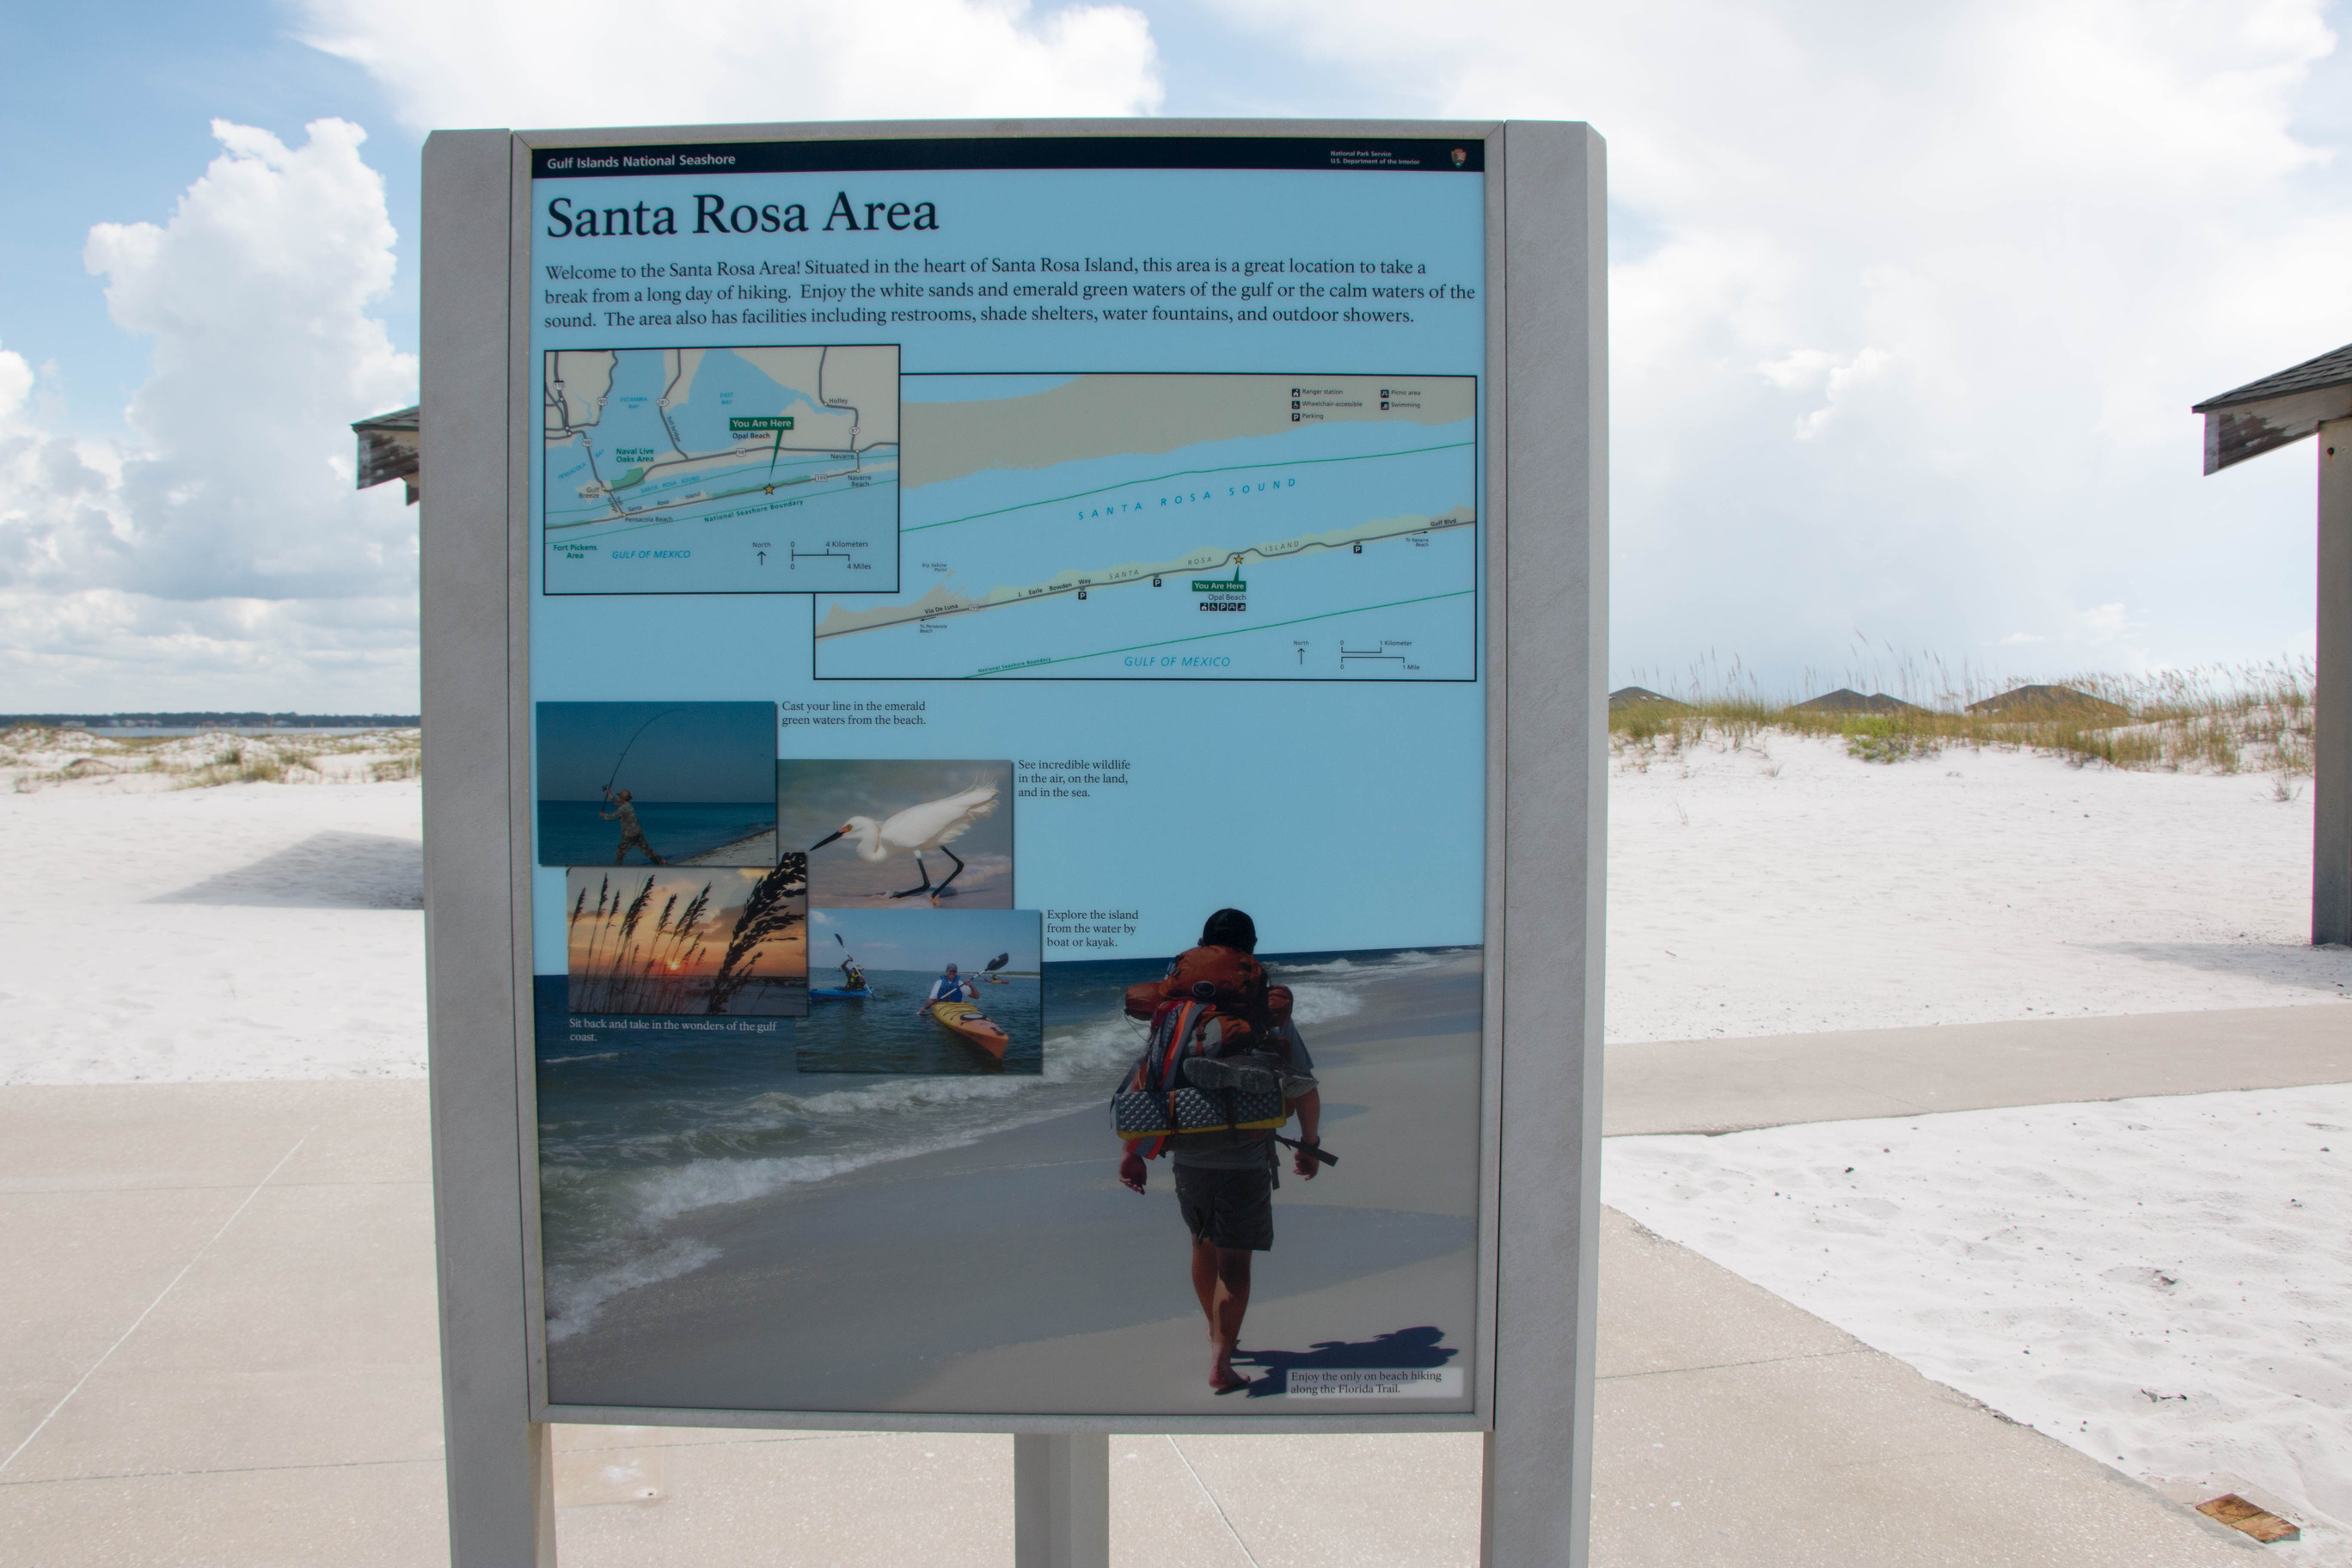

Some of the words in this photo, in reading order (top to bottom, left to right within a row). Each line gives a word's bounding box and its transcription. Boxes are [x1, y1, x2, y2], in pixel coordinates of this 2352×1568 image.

[547, 157, 573, 168] Gulf
[577, 156, 619, 168] Islands
[623, 155, 675, 167] National
[679, 154, 736, 165] Seashore
[547, 198, 677, 236] Santa
[692, 194, 809, 232] Rosa
[822, 191, 940, 230] Area
[544, 265, 616, 279] Welcome
[621, 266, 636, 278] to
[640, 263, 665, 277] the
[670, 262, 712, 276] Santa
[716, 261, 755, 275] Rosa
[759, 261, 799, 274] Area!
[805, 260, 869, 273] Situated
[874, 260, 889, 273] in
[894, 260, 919, 273] the
[924, 260, 966, 272] heart
[971, 259, 987, 272] of
[992, 259, 1036, 272] Santa
[1040, 259, 1080, 271] Rosa
[1085, 258, 1138, 273] Island,
[1142, 258, 1172, 271] this
[1177, 261, 1210, 272] area
[1215, 258, 1227, 272] is
[1232, 261, 1240, 272] a
[1244, 260, 1285, 276] great
[1289, 258, 1355, 273] location
[1360, 261, 1375, 273] to
[1381, 259, 1413, 273] take
[1418, 263, 1427, 273] a
[544, 312, 596, 328] sound.
[603, 312, 634, 326] The
[639, 315, 671, 325] area
[676, 311, 707, 324] also
[711, 311, 737, 323] has
[742, 310, 806, 322] facilities
[812, 310, 886, 325] including
[891, 309, 976, 322] restrooms,
[980, 309, 1026, 320] shade
[1032, 309, 1098, 322] shelters,
[1102, 308, 1148, 320] water
[1152, 308, 1233, 322] fountains,
[1238, 307, 1267, 320] and
[1273, 307, 1339, 321] outdoor
[1344, 307, 1414, 322] showers.
[732, 419, 750, 428] You
[752, 419, 769, 428] Are
[770, 419, 791, 428] Here
[732, 432, 749, 441] Opal
[1077, 502, 1142, 520] SANTA
[1161, 491, 1211, 506] ROSA
[1229, 478, 1296, 496] SOUND
[704, 512, 734, 524] National
[736, 507, 769, 517] Seashore
[770, 499, 804, 511] Boundary
[569, 543, 597, 552] Pickens
[638, 550, 651, 559] OF
[1124, 657, 1155, 666] GULF
[1161, 657, 1177, 666] OF
[1181, 657, 1230, 666] MEXICO
[781, 701, 805, 710] Cast
[806, 704, 830, 714] your
[832, 701, 851, 710] line
[854, 701, 863, 710] in
[866, 701, 882, 710] the
[885, 701, 925, 710] emerald
[781, 718, 810, 726] green
[848, 715, 872, 724] from
[875, 715, 891, 724] the
[893, 715, 926, 725] beach.
[1019, 760, 1036, 769] See
[1038, 760, 1090, 769] incredible
[1092, 760, 1130, 769] wildlife
[1019, 774, 1028, 782] in
[1031, 774, 1047, 783] the
[1050, 774, 1065, 784] air,
[1084, 774, 1099, 783] the
[1103, 774, 1128, 784] land,
[1019, 787, 1037, 797] and
[1040, 787, 1050, 797] in
[1053, 787, 1069, 797] the
[1047, 910, 1087, 922] Explore
[1090, 910, 1106, 919] the
[1109, 910, 1138, 919] island
[1047, 923, 1071, 933] from
[1075, 923, 1090, 933] the
[1124, 924, 1136, 935] by
[1045, 937, 1069, 946] boat
[1087, 937, 1118, 949] kayak.
[569, 1019, 582, 1027] Sit
[584, 1019, 607, 1028] back
[609, 1020, 628, 1028] and
[629, 1020, 650, 1029] take
[652, 1020, 662, 1029] in
[664, 1020, 679, 1029] the
[682, 1021, 725, 1030] wonders
[726, 1021, 738, 1030] of
[739, 1021, 756, 1031] the
[756, 1022, 777, 1033] gulf
[1292, 1372, 1320, 1383] Enjoy
[1322, 1372, 1338, 1381] the
[1340, 1369, 1362, 1382] only
[1364, 1369, 1377, 1381] on
[1380, 1369, 1408, 1381] beach
[1411, 1369, 1442, 1382] hiking
[1291, 1383, 1318, 1395] along
[1320, 1383, 1335, 1393] the
[1338, 1383, 1373, 1393] Florida
[1375, 1383, 1400, 1393] Trail.
